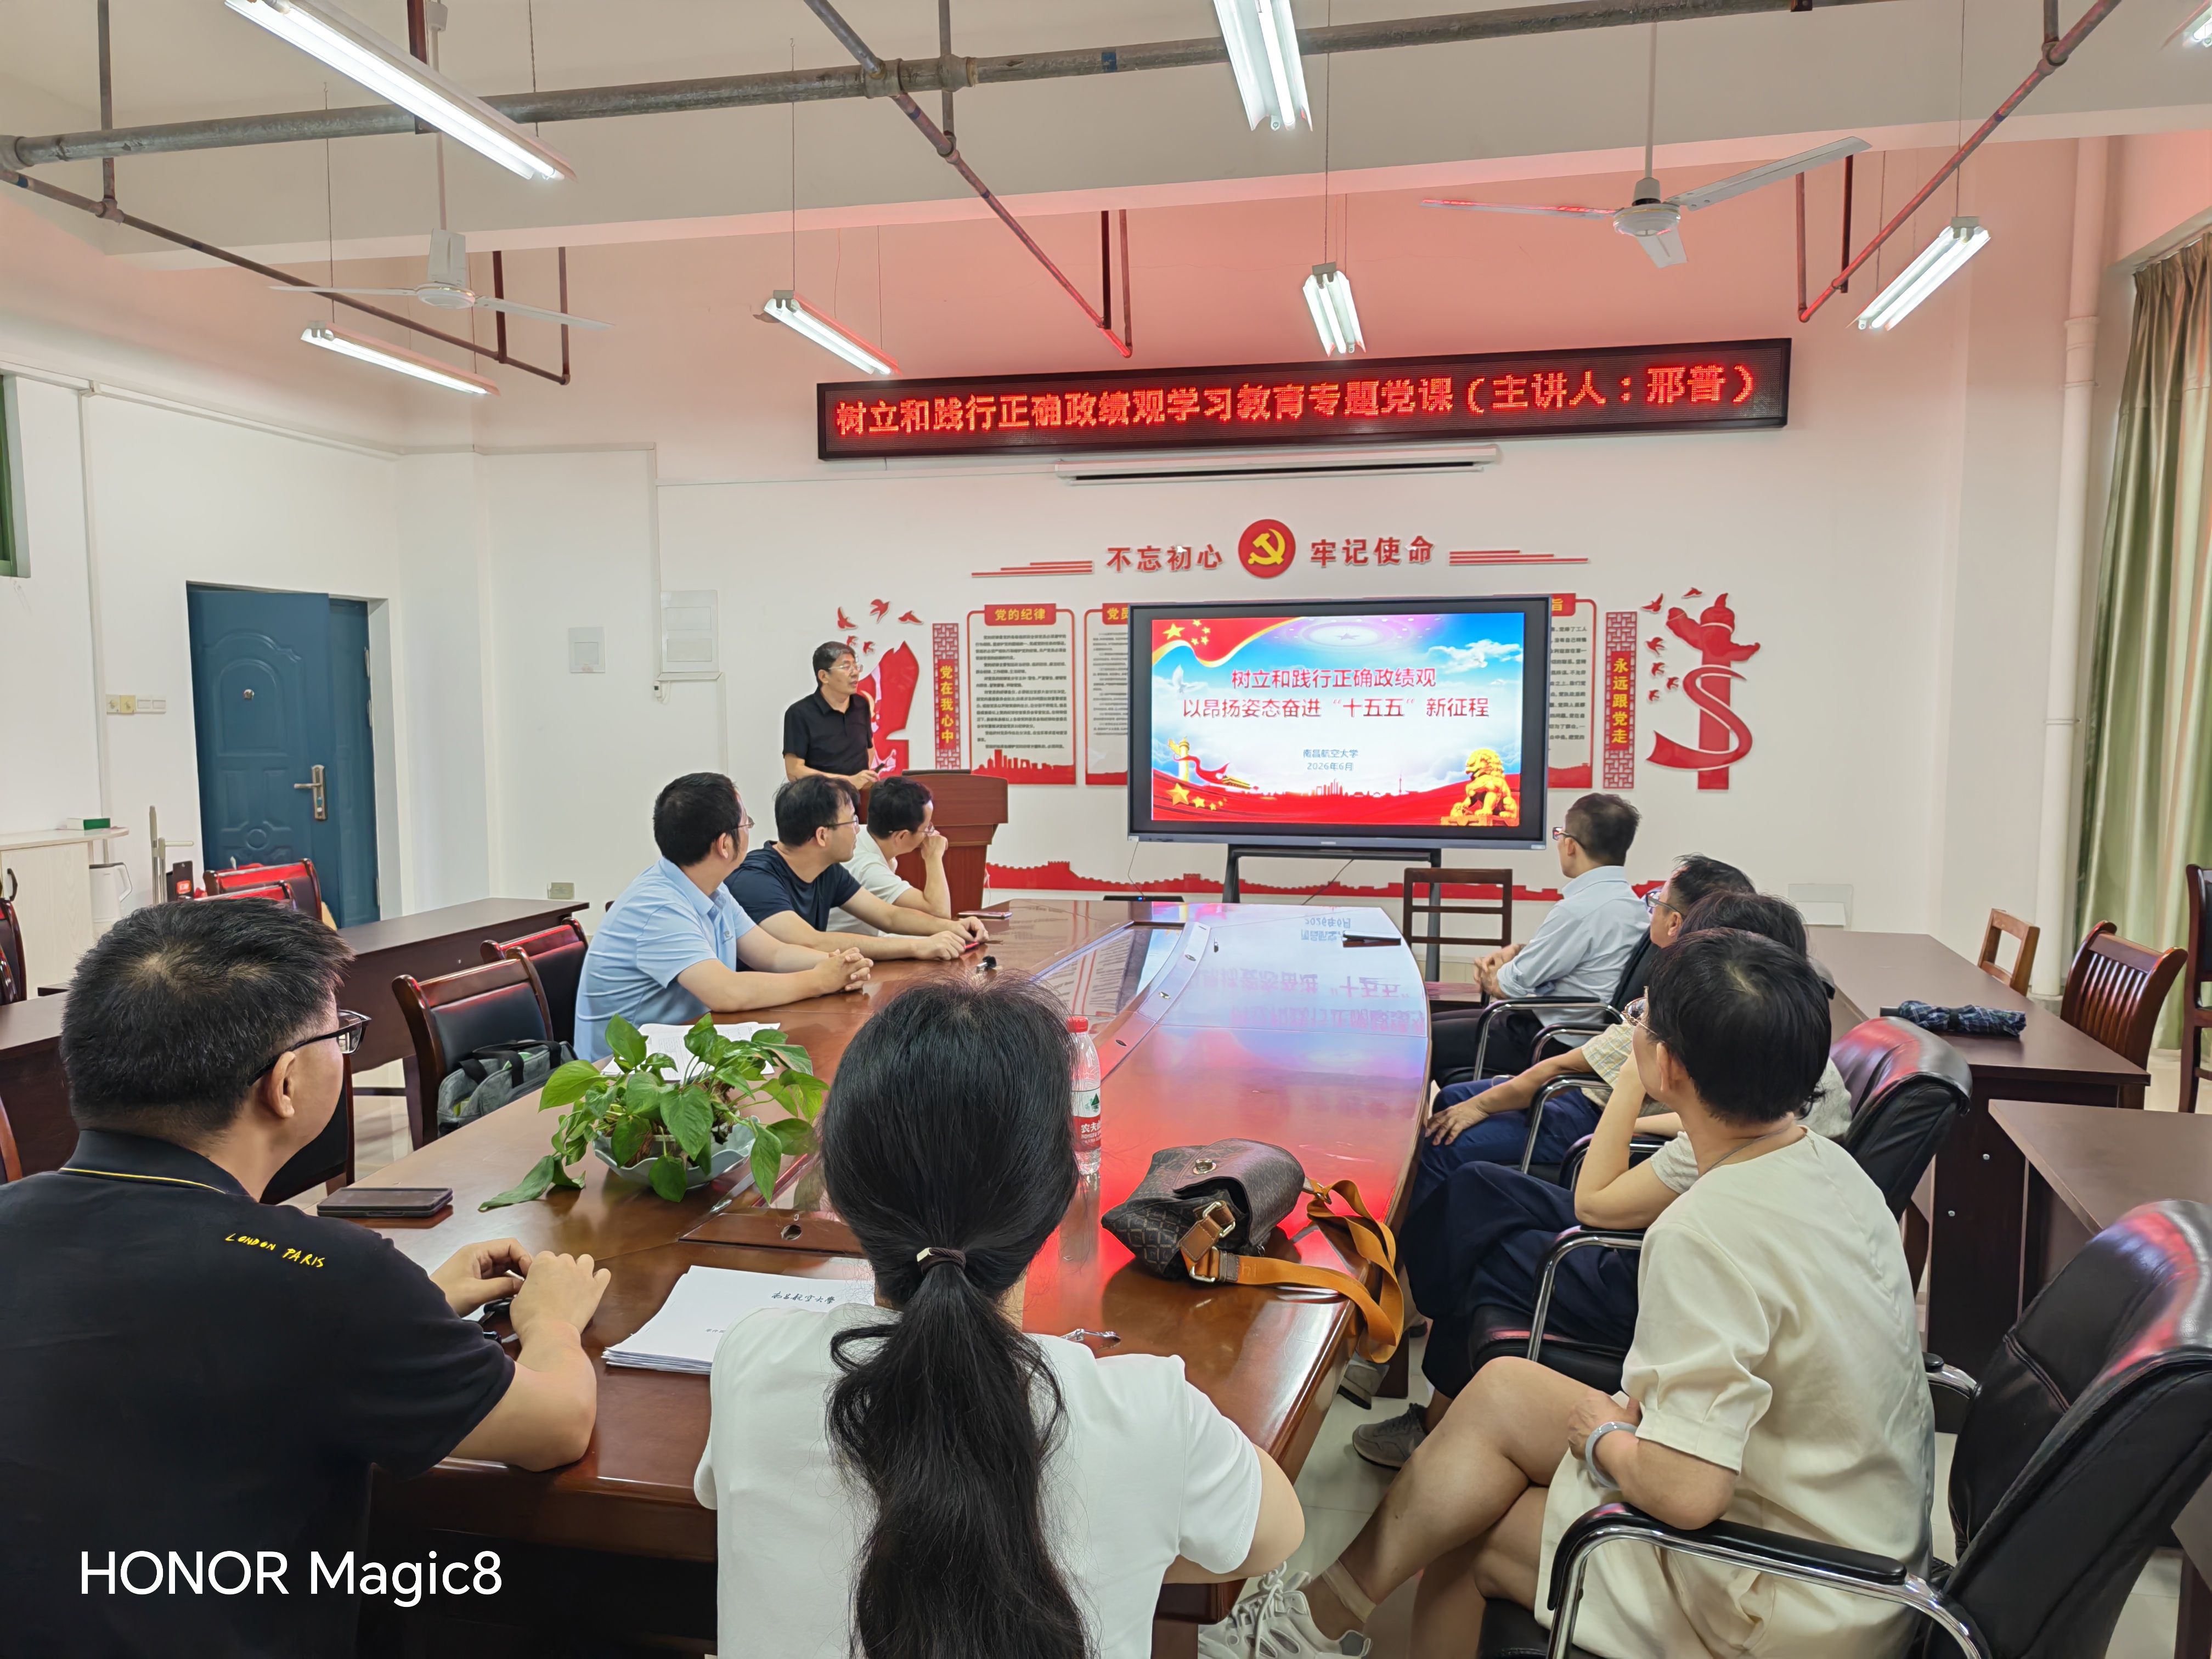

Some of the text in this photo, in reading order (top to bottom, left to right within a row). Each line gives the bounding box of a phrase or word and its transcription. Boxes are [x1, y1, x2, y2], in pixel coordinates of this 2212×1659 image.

[1106, 544, 1223, 573] 不忘初心
[1310, 535, 1434, 568] 牢记使命
[995, 607, 1046, 621] 党的纪律
[1231, 668, 1436, 689] 树立和践行正确政绩观
[939, 665, 954, 744] 党在我心中
[1611, 658, 1629, 744] 永远跟党走
[1303, 748, 1358, 758] 南昌航空大学
[1307, 762, 1353, 771] 2026年6月
[225, 1233, 325, 1267] LONDON PARIS
